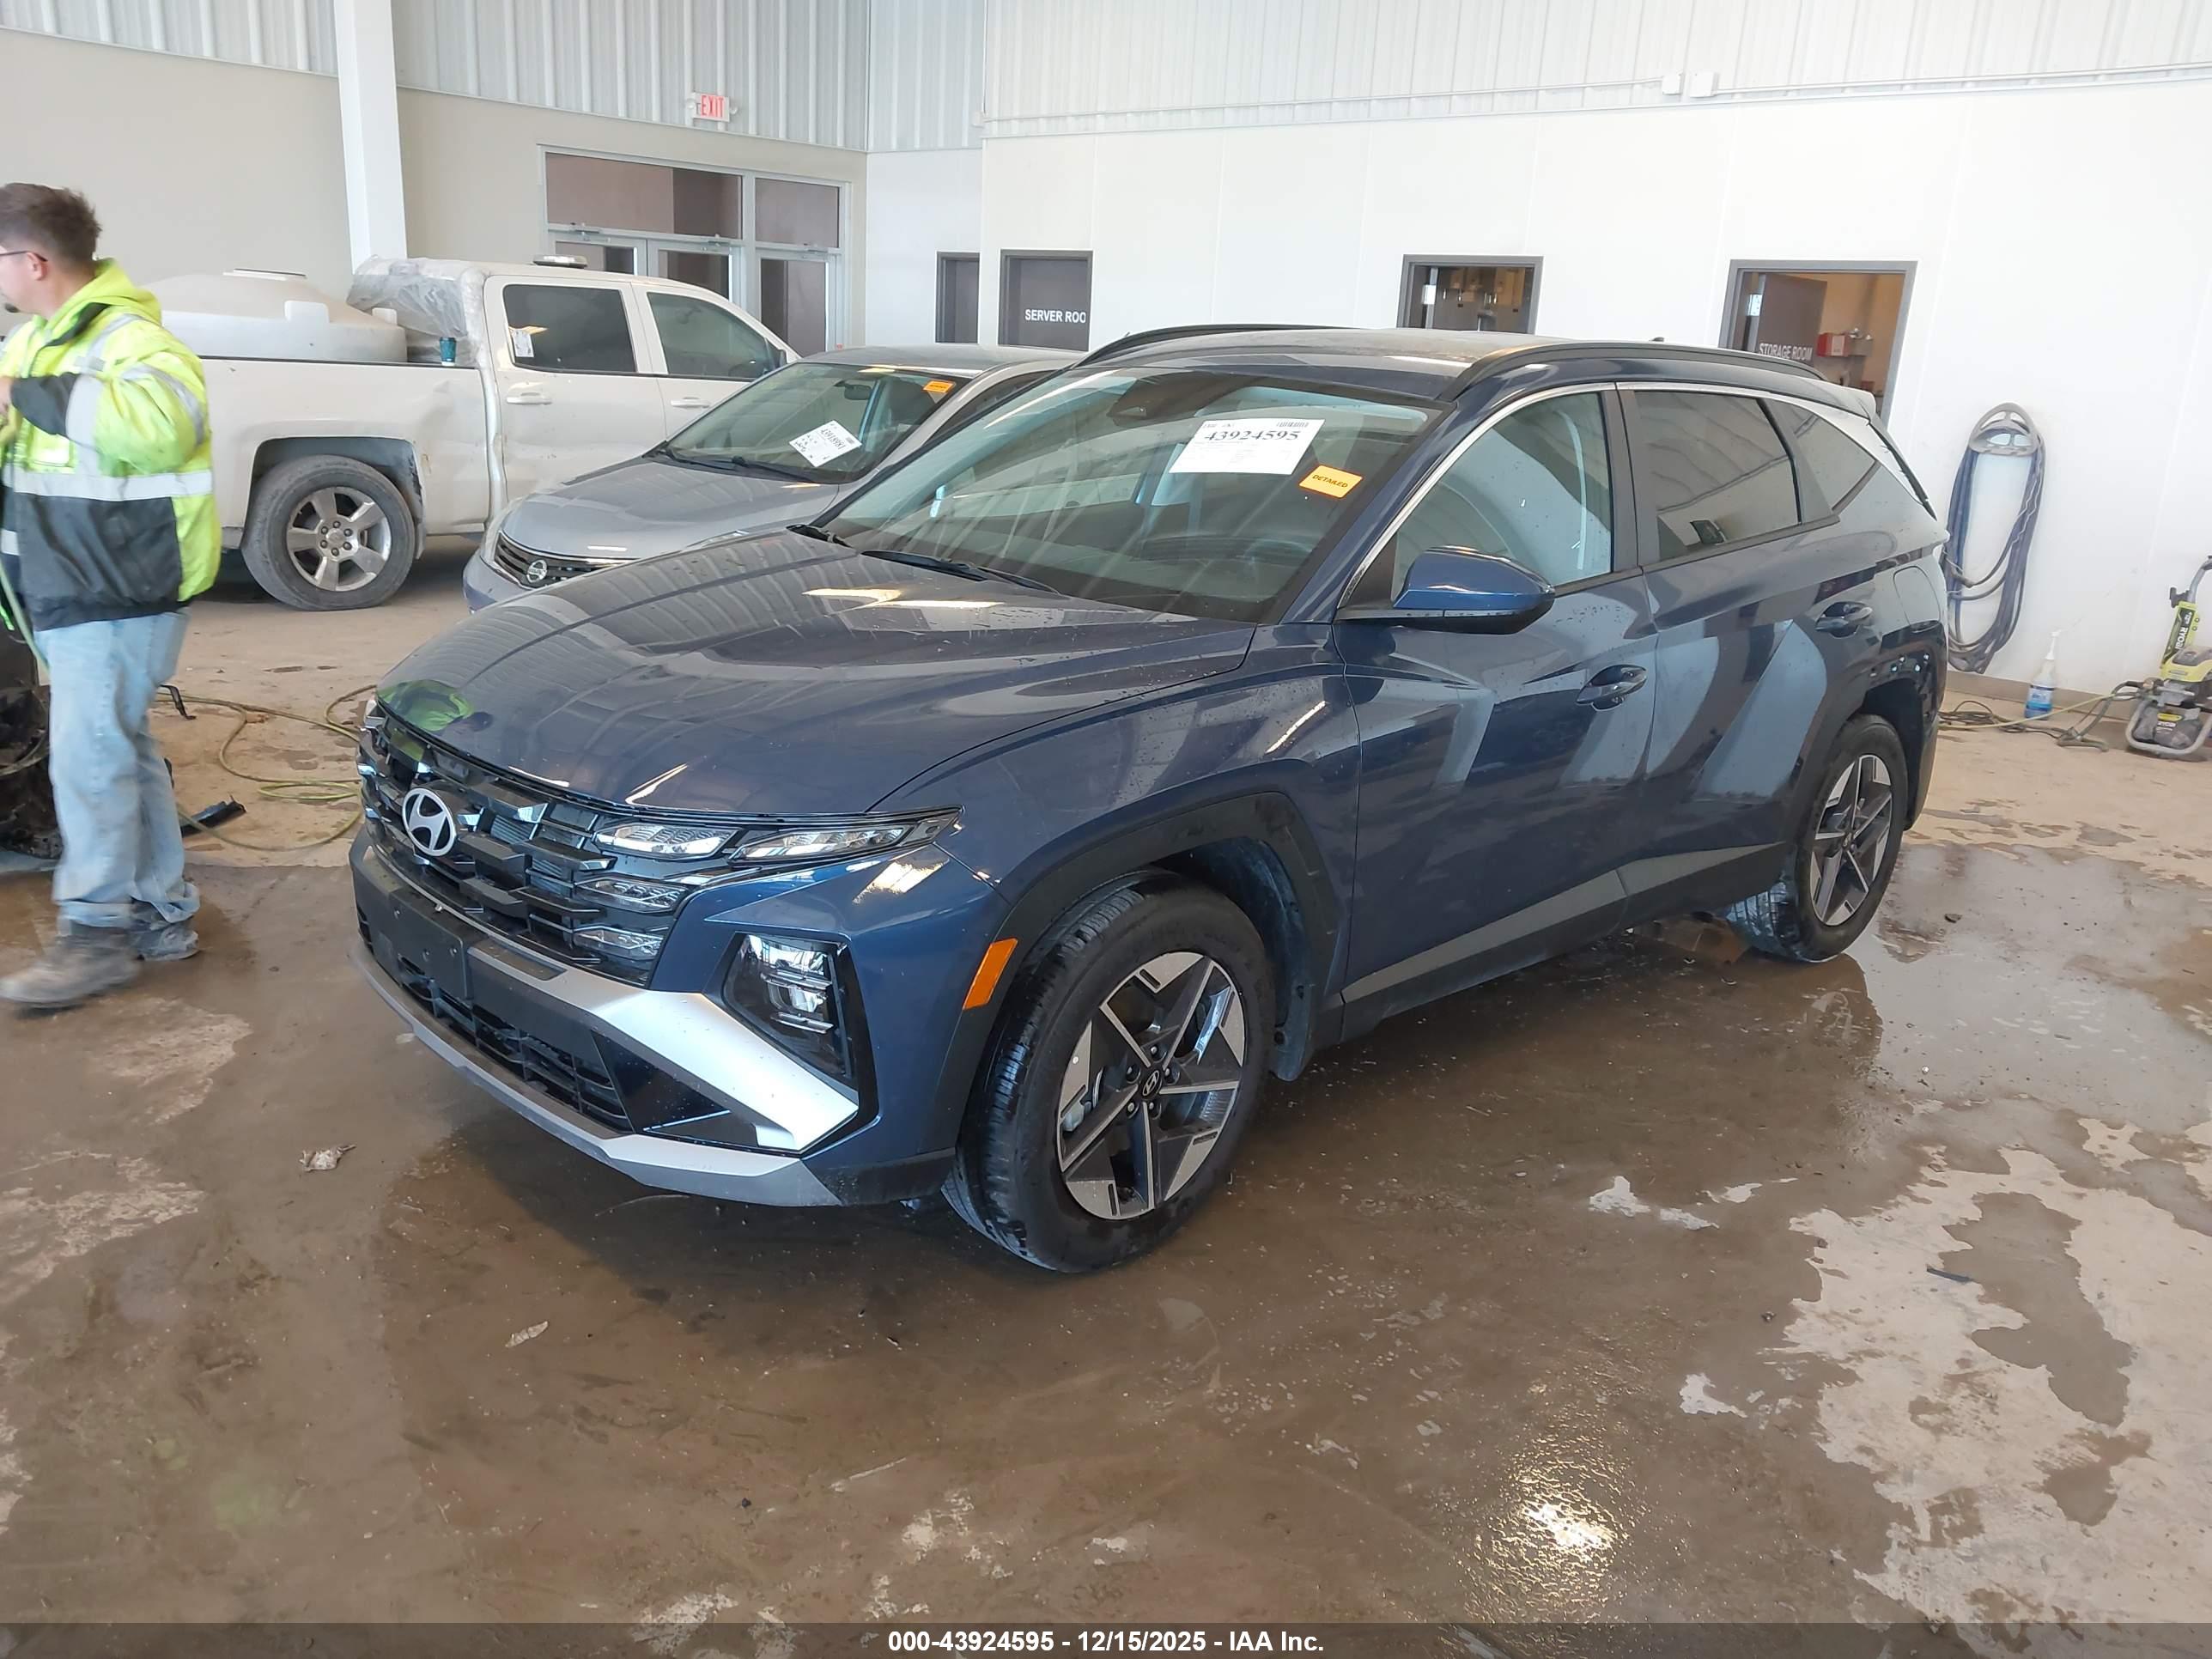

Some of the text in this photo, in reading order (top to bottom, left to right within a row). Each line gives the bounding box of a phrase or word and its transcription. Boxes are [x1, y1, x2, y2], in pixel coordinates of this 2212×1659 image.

[701, 94, 724, 118] EXIT
[1024, 308, 1063, 322] SERVER
[1759, 343, 1813, 361] STORAGE ROOM
[1204, 430, 1301, 441] 43924595
[1312, 474, 1348, 488] DETAILED
